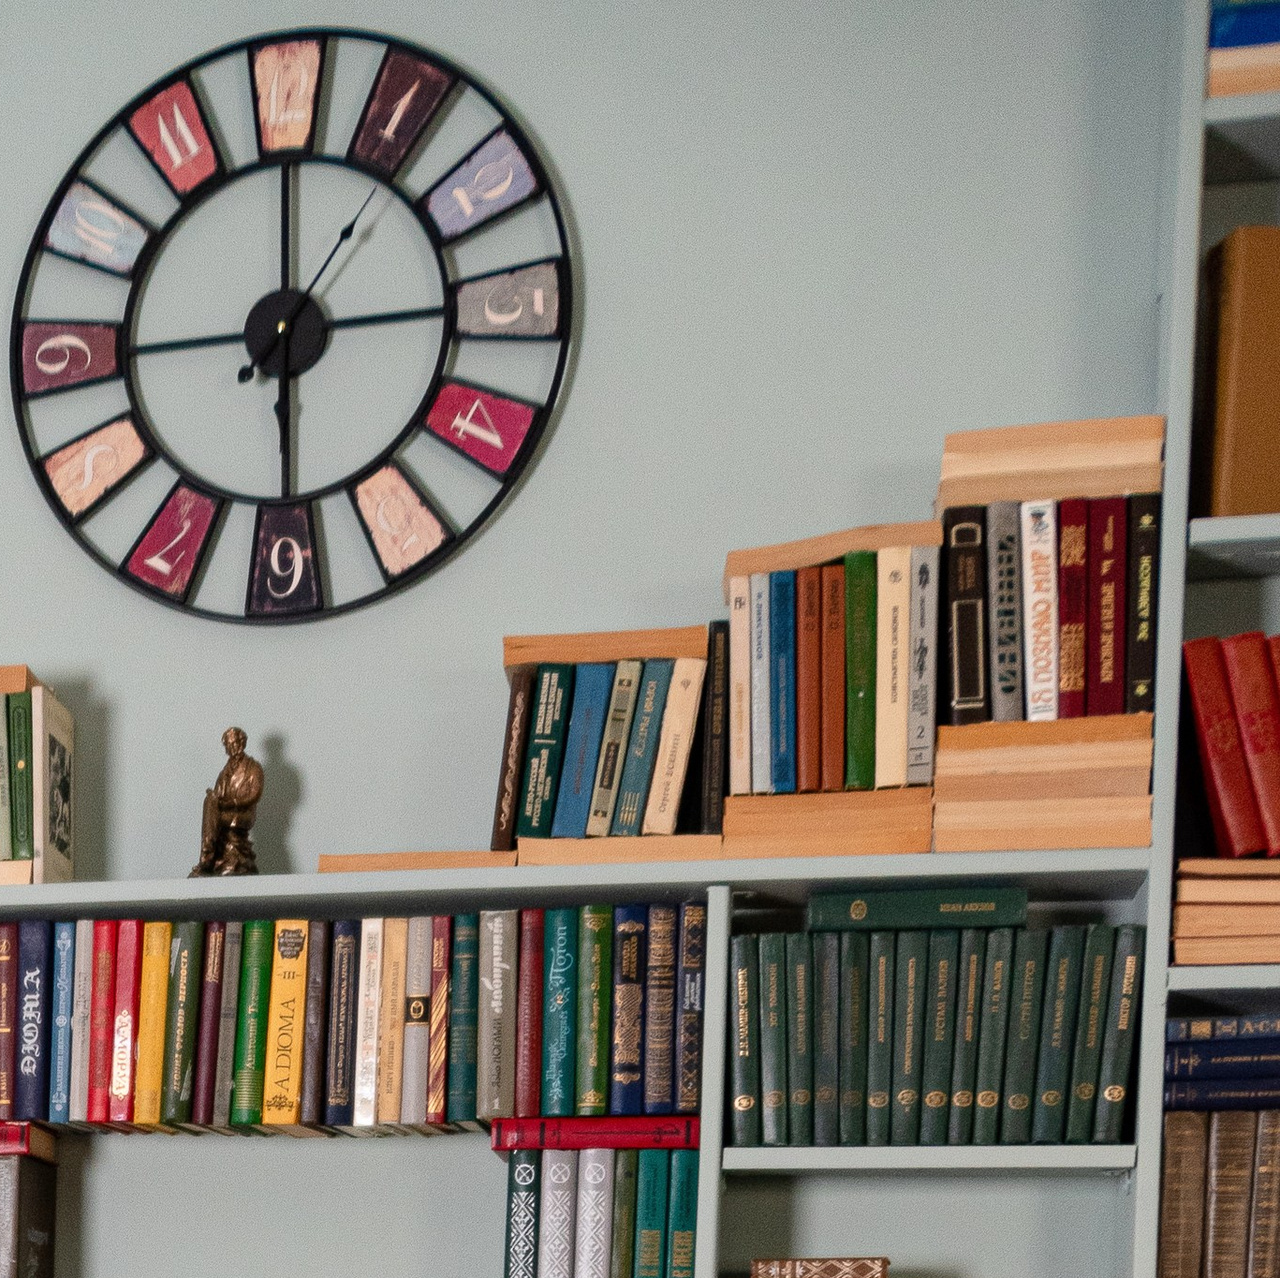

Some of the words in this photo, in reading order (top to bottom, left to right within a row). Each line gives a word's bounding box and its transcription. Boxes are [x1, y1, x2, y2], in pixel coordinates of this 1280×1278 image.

[269, 66, 309, 128] 12
[378, 78, 422, 142] 1
[155, 99, 205, 172] 11
[450, 152, 514, 217] 2
[73, 199, 125, 256] 10
[34, 333, 92, 375] 9
[449, 398, 506, 452] 4
[144, 518, 192, 577] 7
[266, 536, 304, 598] 6
[1030, 550, 1051, 593] МИР
[1030, 598, 1052, 684] ПОЗНАЮ
[1030, 689, 1052, 703] Я
[21, 967, 42, 1076] ДЮМА
[276, 997, 296, 1073] ДЮМА
